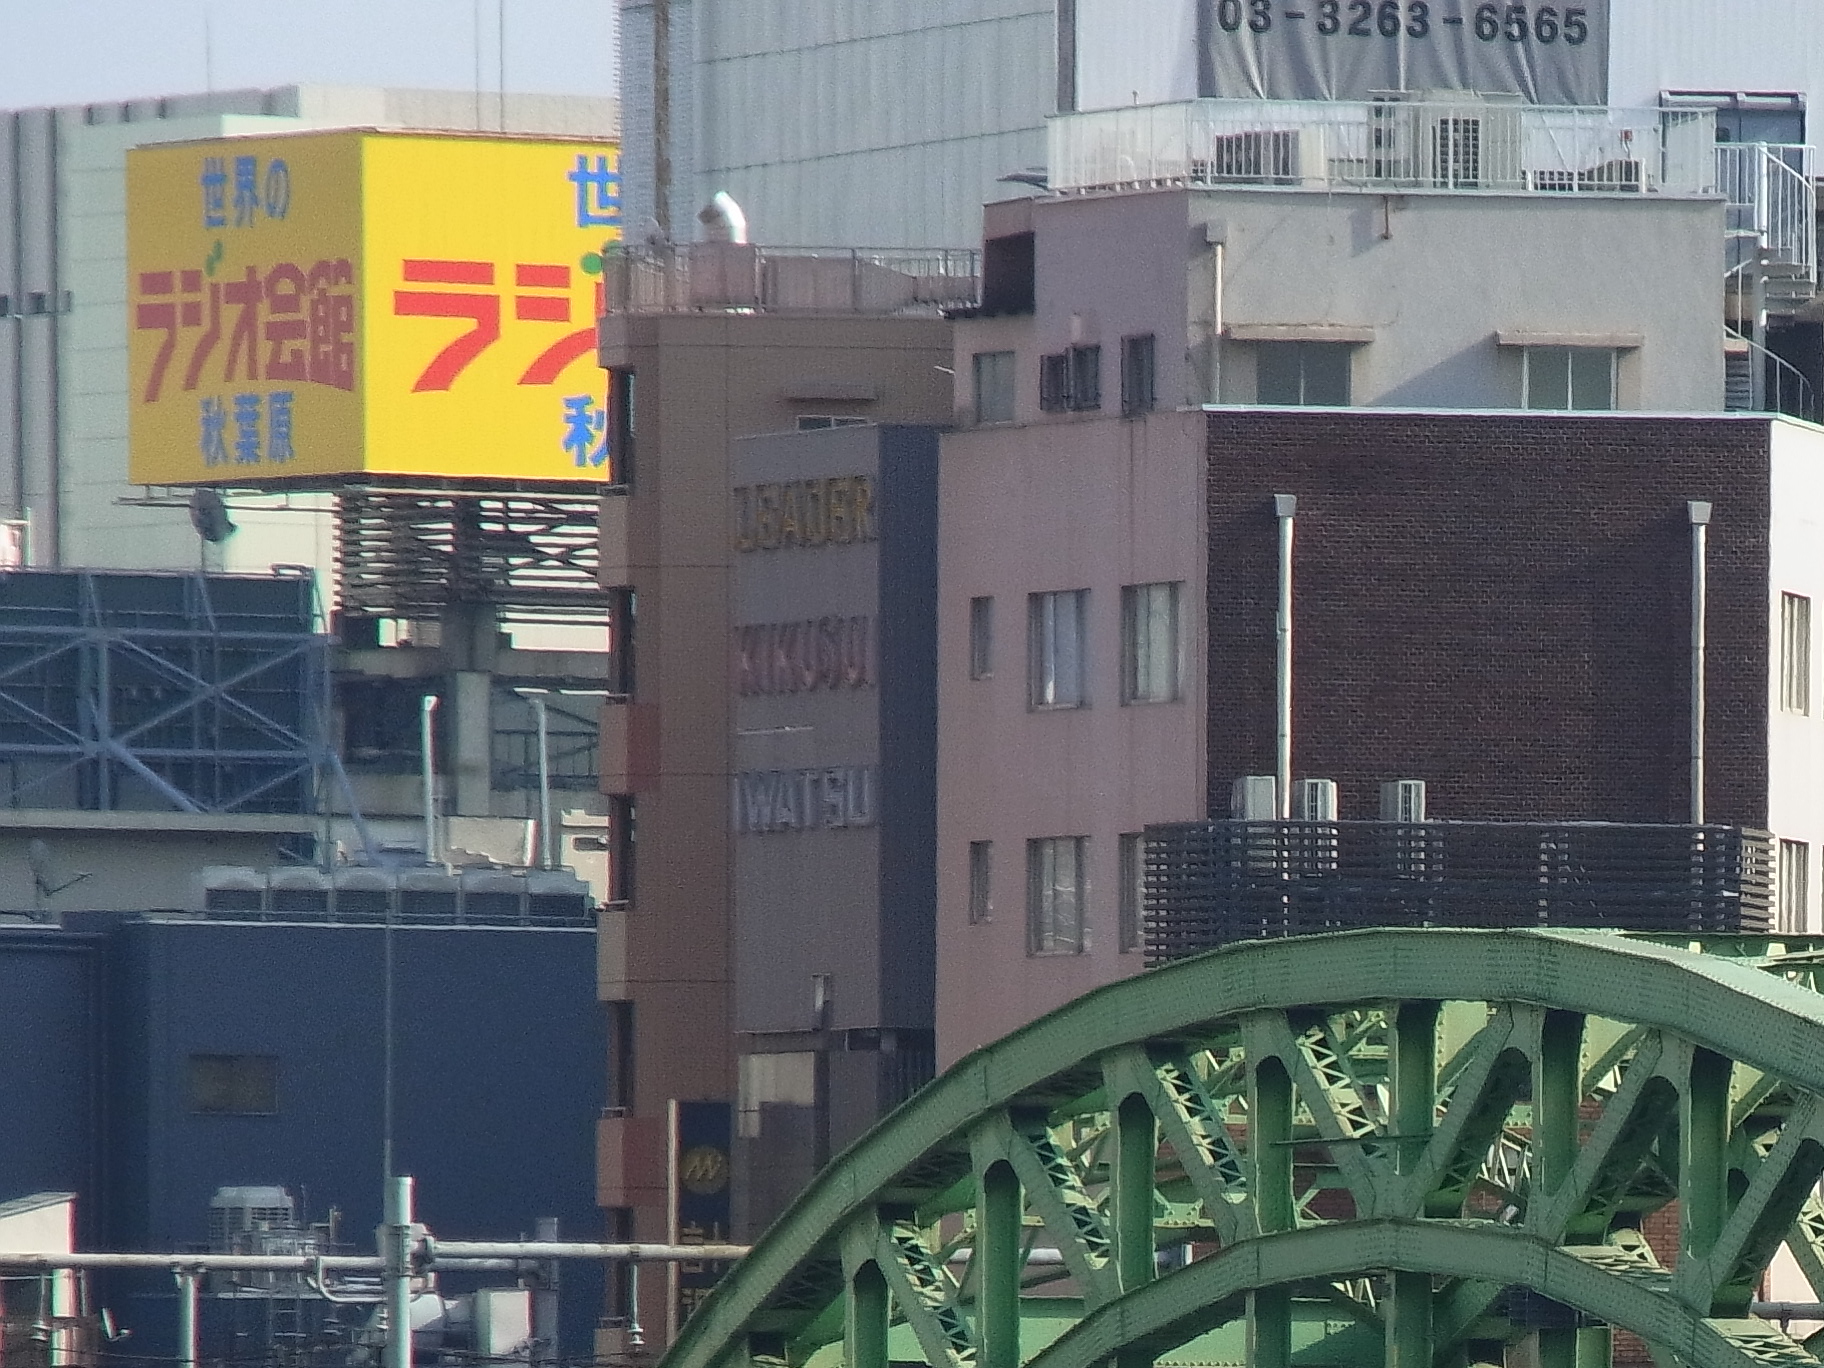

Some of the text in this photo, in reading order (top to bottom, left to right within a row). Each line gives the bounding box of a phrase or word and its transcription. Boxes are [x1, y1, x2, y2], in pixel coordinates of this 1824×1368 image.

[1217, 0, 1589, 46] 03-3263-6565
[202, 155, 290, 228] 世界の
[137, 241, 355, 403] ラジオ会館
[201, 391, 294, 467] 秋葉原
[734, 475, 877, 552] LEADER
[733, 765, 877, 833] IWATSU
